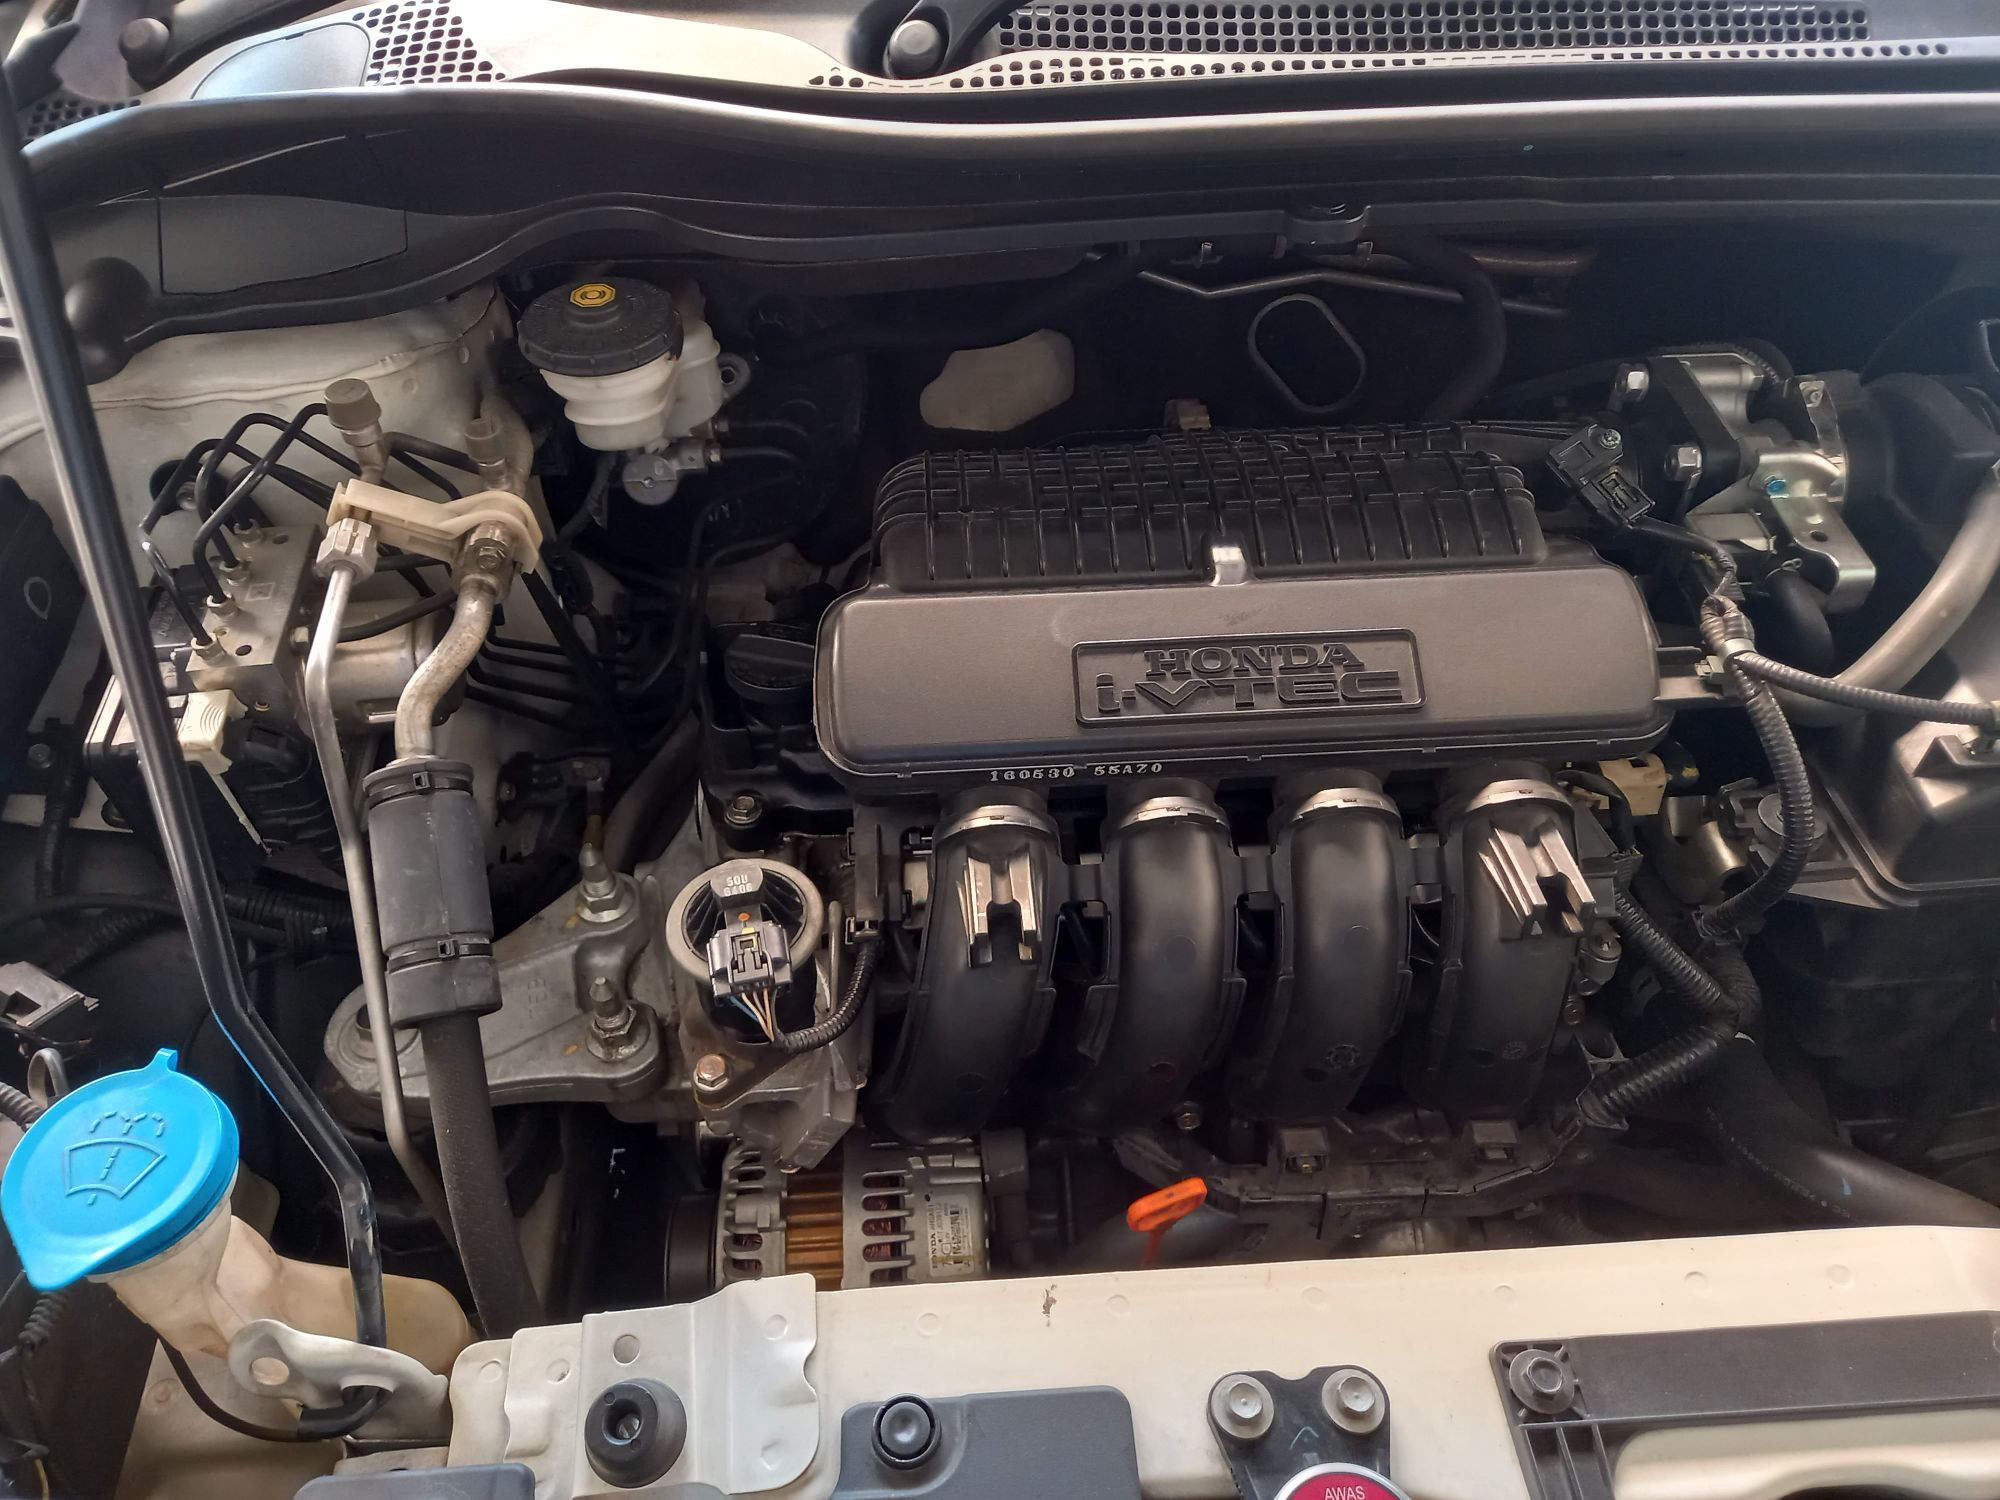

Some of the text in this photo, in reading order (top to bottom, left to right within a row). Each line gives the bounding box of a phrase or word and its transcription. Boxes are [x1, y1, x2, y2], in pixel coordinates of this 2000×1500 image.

[1144, 643, 1364, 677] HONDA
[990, 767, 1075, 781] 160530
[1324, 1485, 1365, 1500] AWAS
